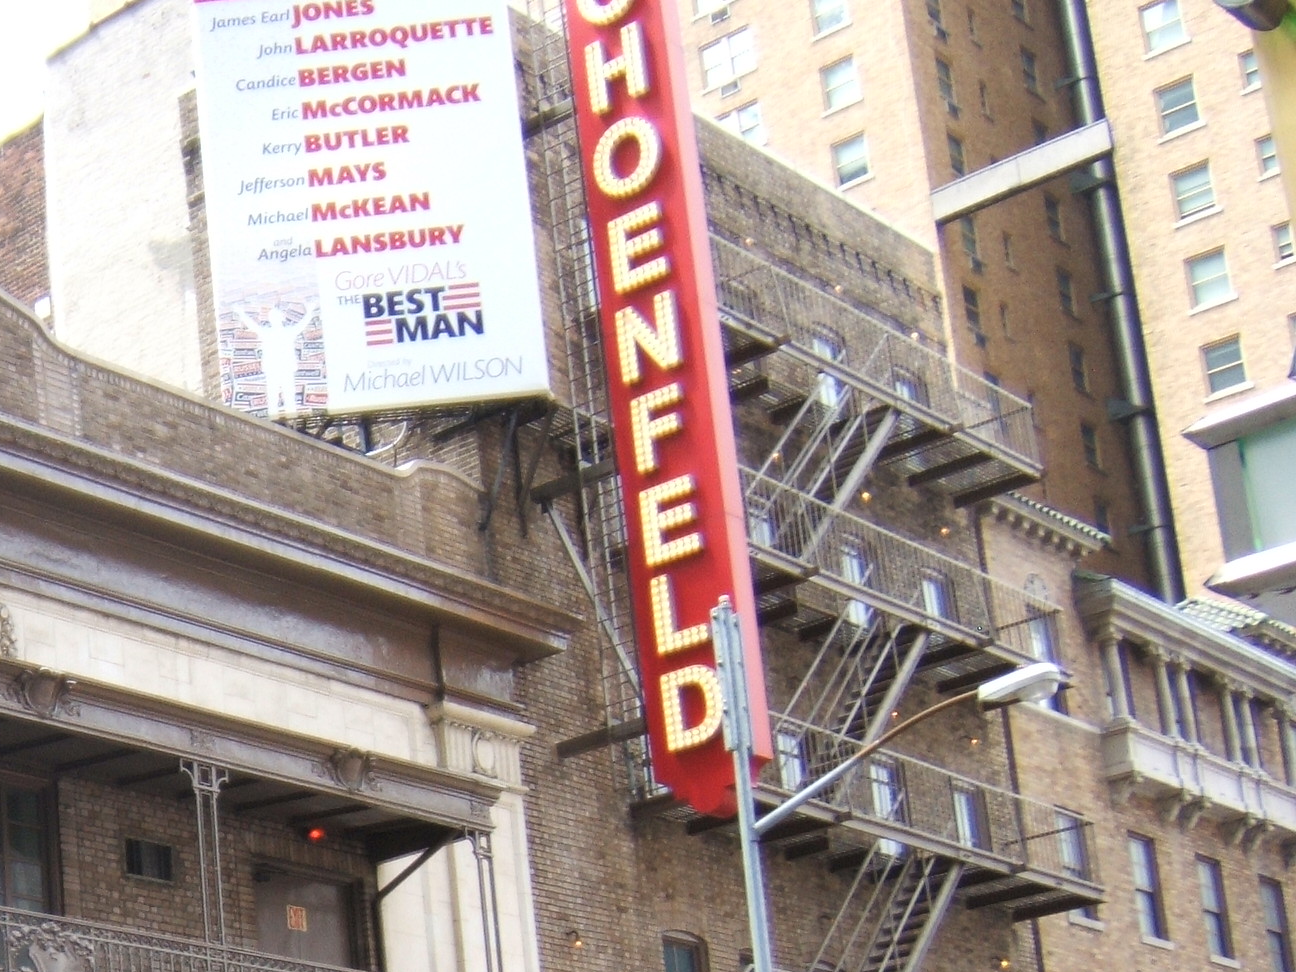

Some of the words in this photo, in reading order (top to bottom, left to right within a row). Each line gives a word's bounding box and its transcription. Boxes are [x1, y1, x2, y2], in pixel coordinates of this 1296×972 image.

[210, 14, 256, 32] James
[261, 9, 289, 24] Earl
[291, 0, 375, 29] JONES
[257, 43, 292, 59] John
[295, 16, 493, 55] LARROQUETTE
[236, 73, 296, 92] Candice
[298, 58, 407, 87] BERGEN
[271, 106, 299, 122] Eric
[301, 83, 481, 120] McCORMACK
[262, 140, 302, 158] Kerry
[304, 124, 410, 153] BUTLER
[237, 175, 305, 196] Jefferson
[307, 161, 387, 187] MAYS
[247, 207, 308, 227] Michael
[311, 192, 431, 222] McKEAN
[257, 244, 312, 262] Angela
[314, 224, 465, 258] LANSBURY
[274, 236, 292, 246] and
[335, 270, 385, 291] Gore
[388, 260, 467, 285] VIDAL's
[337, 294, 360, 306] THE
[362, 285, 446, 319] BEST
[395, 310, 484, 343] MAN
[343, 366, 425, 393] Michael
[430, 356, 523, 384] WILSON
